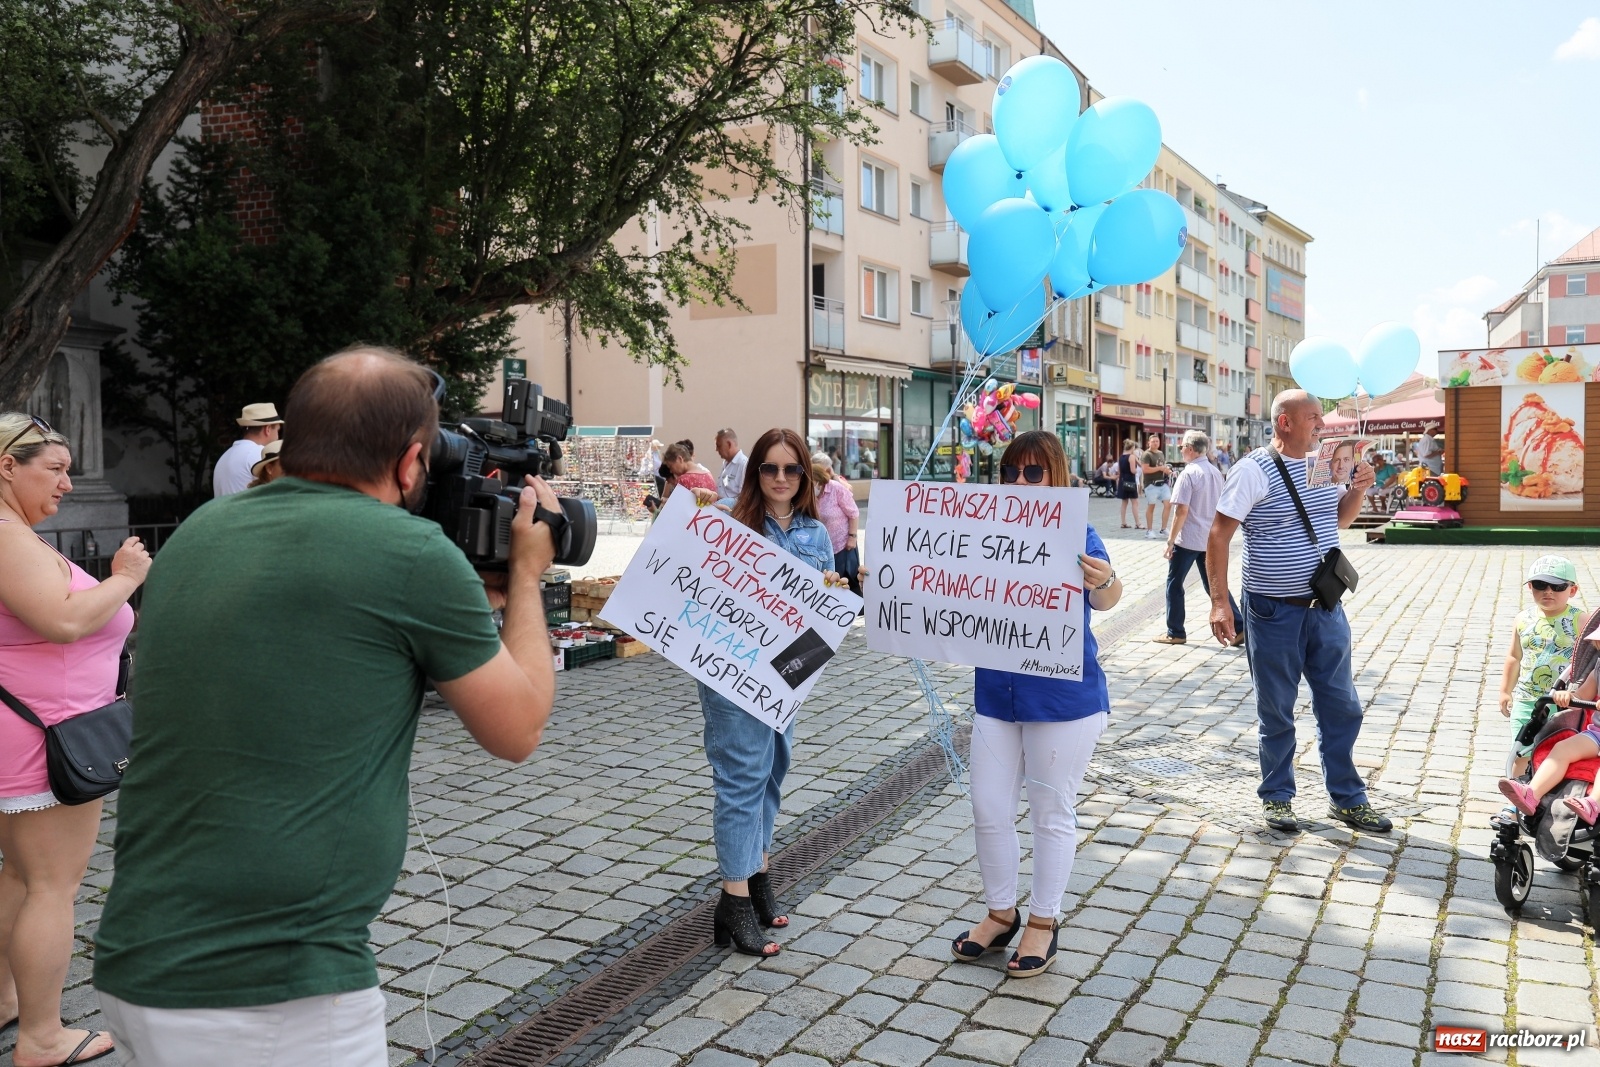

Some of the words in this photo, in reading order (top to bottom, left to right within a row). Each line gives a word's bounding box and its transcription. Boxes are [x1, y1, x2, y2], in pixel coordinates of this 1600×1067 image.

[507, 385, 512, 396] 1
[514, 399, 518, 410] 1
[809, 373, 874, 410] STELLA
[1368, 423, 1399, 433] Gelateria
[1400, 421, 1417, 430] Ciao
[904, 482, 998, 521] PIERWSZA
[1002, 495, 1062, 529] DAMA
[686, 509, 777, 576] KONIEC
[770, 562, 855, 628] MARNEGO
[882, 526, 898, 552] W
[906, 527, 971, 560] KĄCIE
[981, 535, 1051, 566] STAŁA
[645, 549, 671, 575] W
[671, 566, 779, 647] RACIBORZU
[700, 550, 805, 634] POLITYKIERA
[878, 564, 895, 589] O
[909, 564, 997, 602] PRAWACH
[1003, 580, 1083, 612] KOBIET
[677, 600, 761, 669] RAFAŁA
[878, 596, 913, 635] NIE
[922, 606, 1051, 651] WSPOMNIAŁA
[635, 611, 679, 653] SIĘ
[690, 643, 801, 730] WSPIERA!
[1020, 658, 1081, 677] #MamyDość
